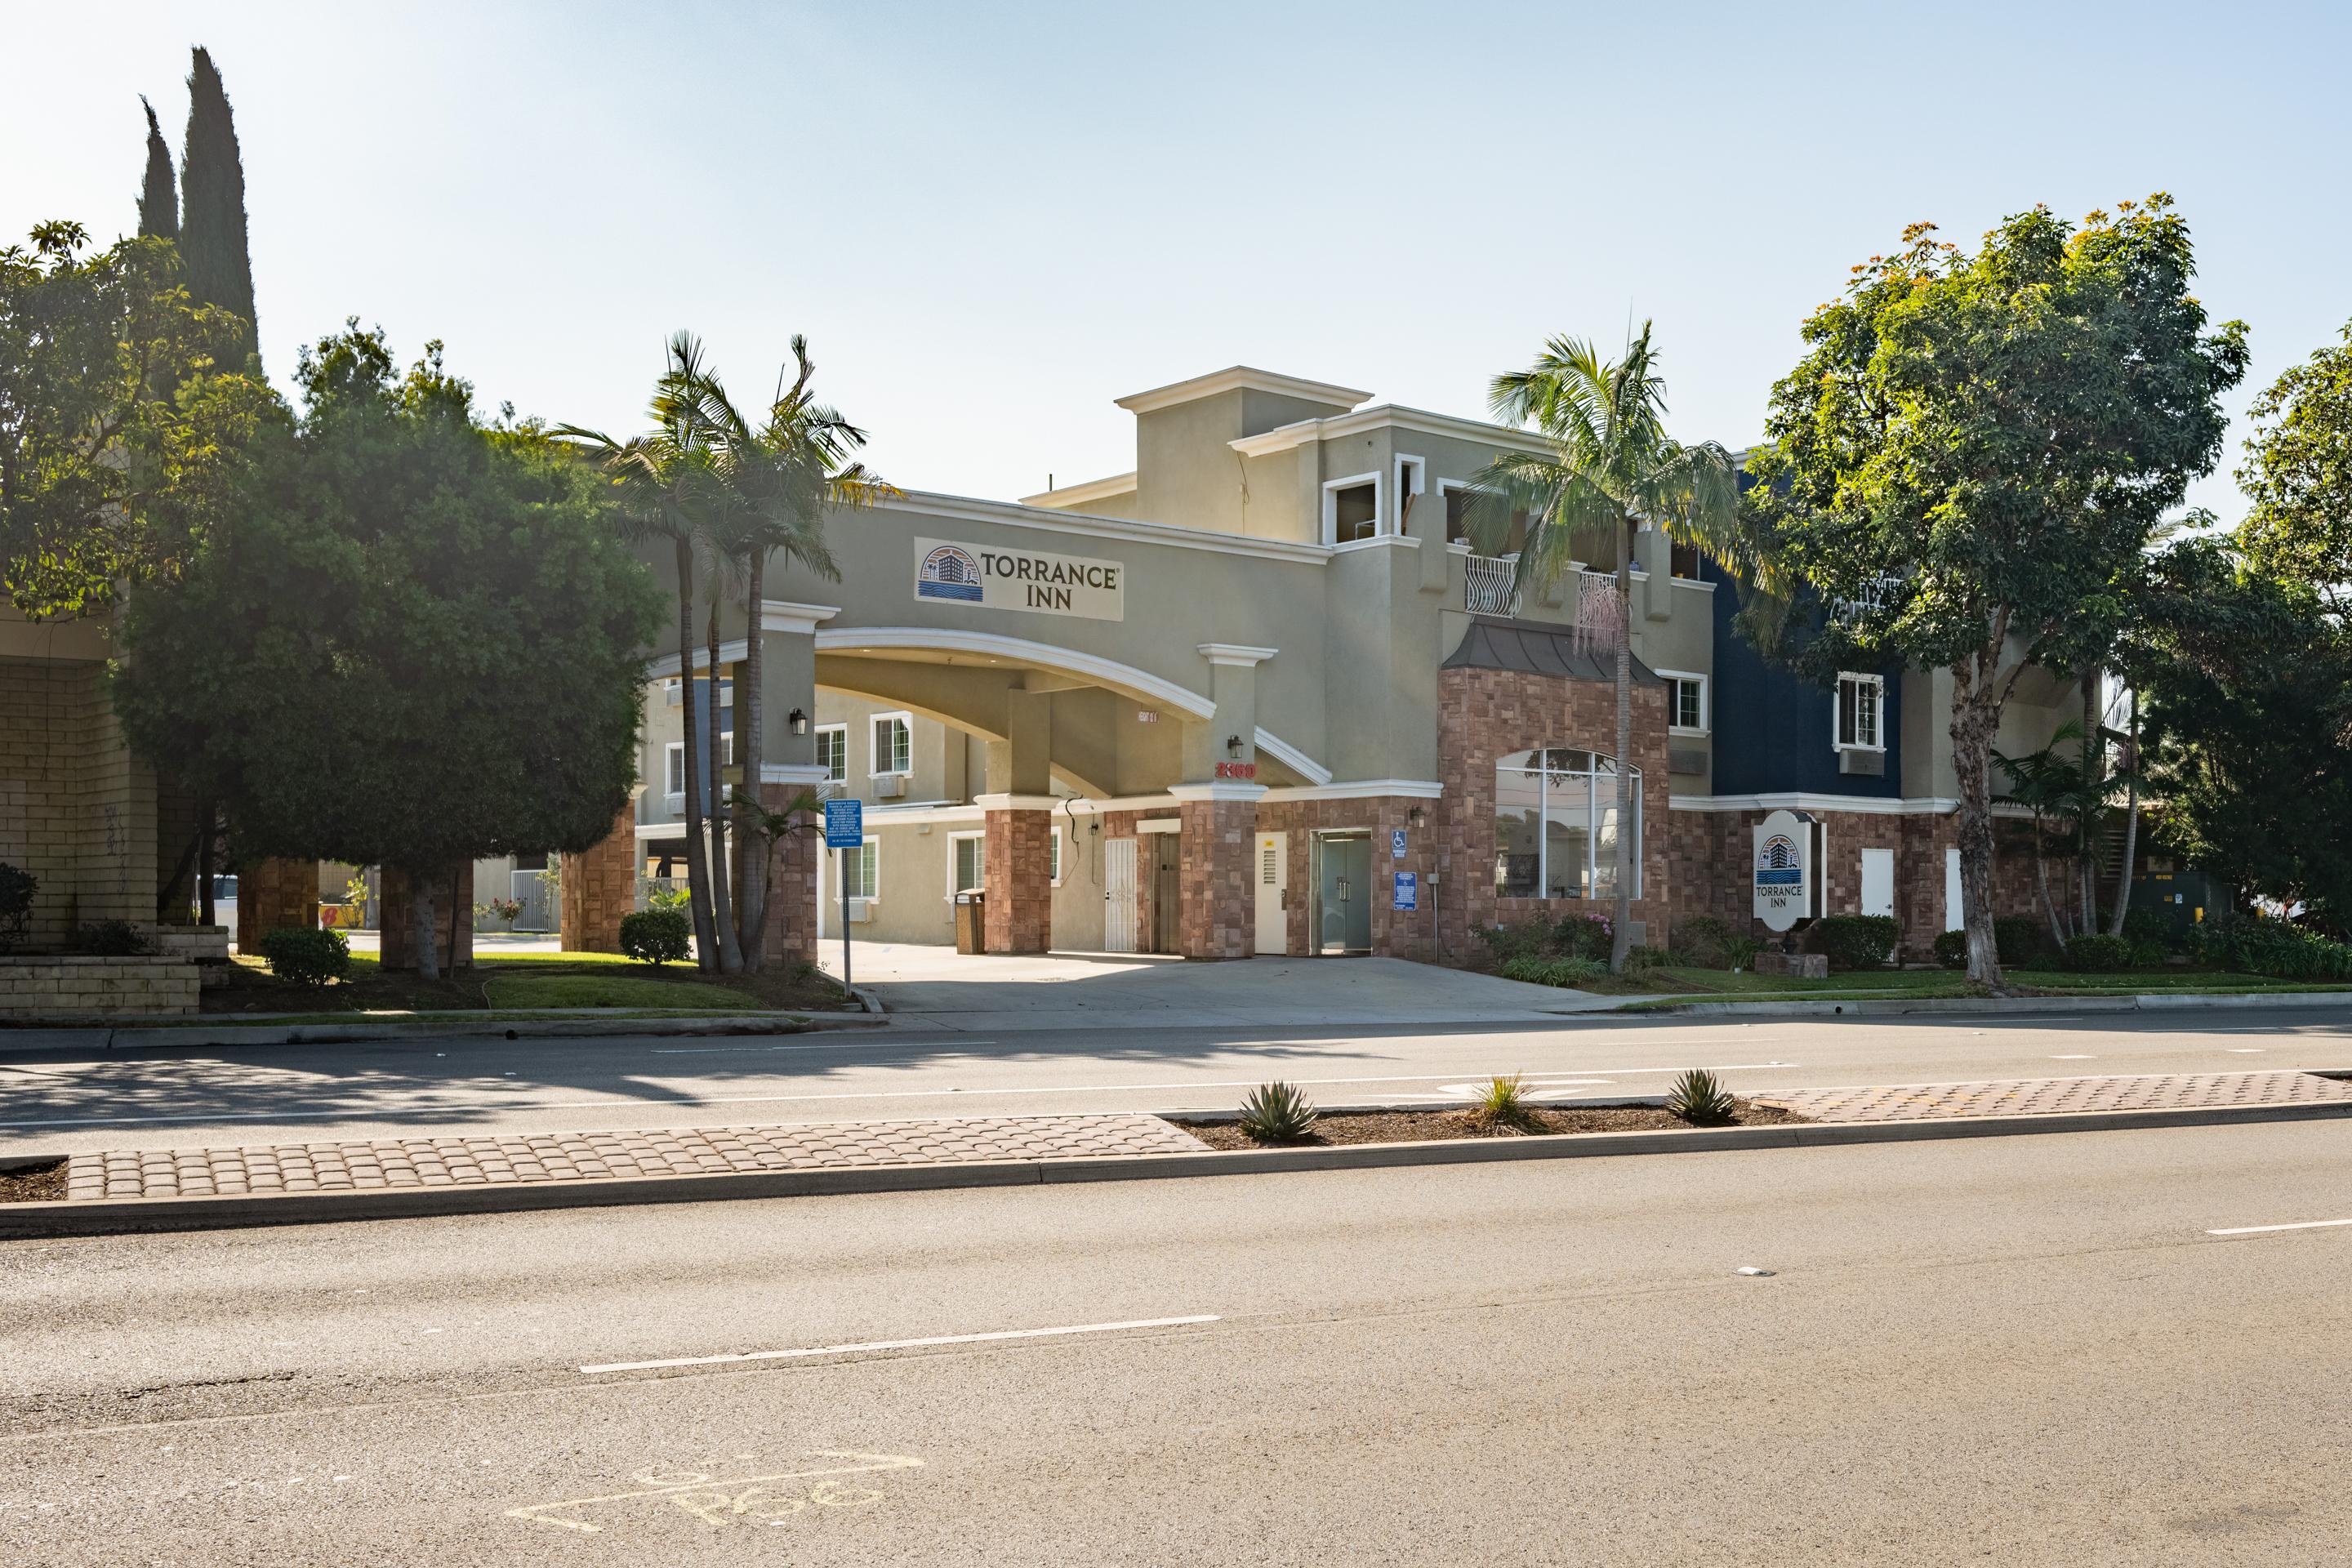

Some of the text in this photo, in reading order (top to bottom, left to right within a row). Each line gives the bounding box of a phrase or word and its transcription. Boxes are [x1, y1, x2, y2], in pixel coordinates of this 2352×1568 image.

[980, 553, 1117, 590] TORRANCE
[1027, 584, 1072, 611] INN
[1215, 762, 1255, 778] 2360
[1756, 886, 1802, 897] TORRANCE
[1770, 898, 1787, 908] INN
